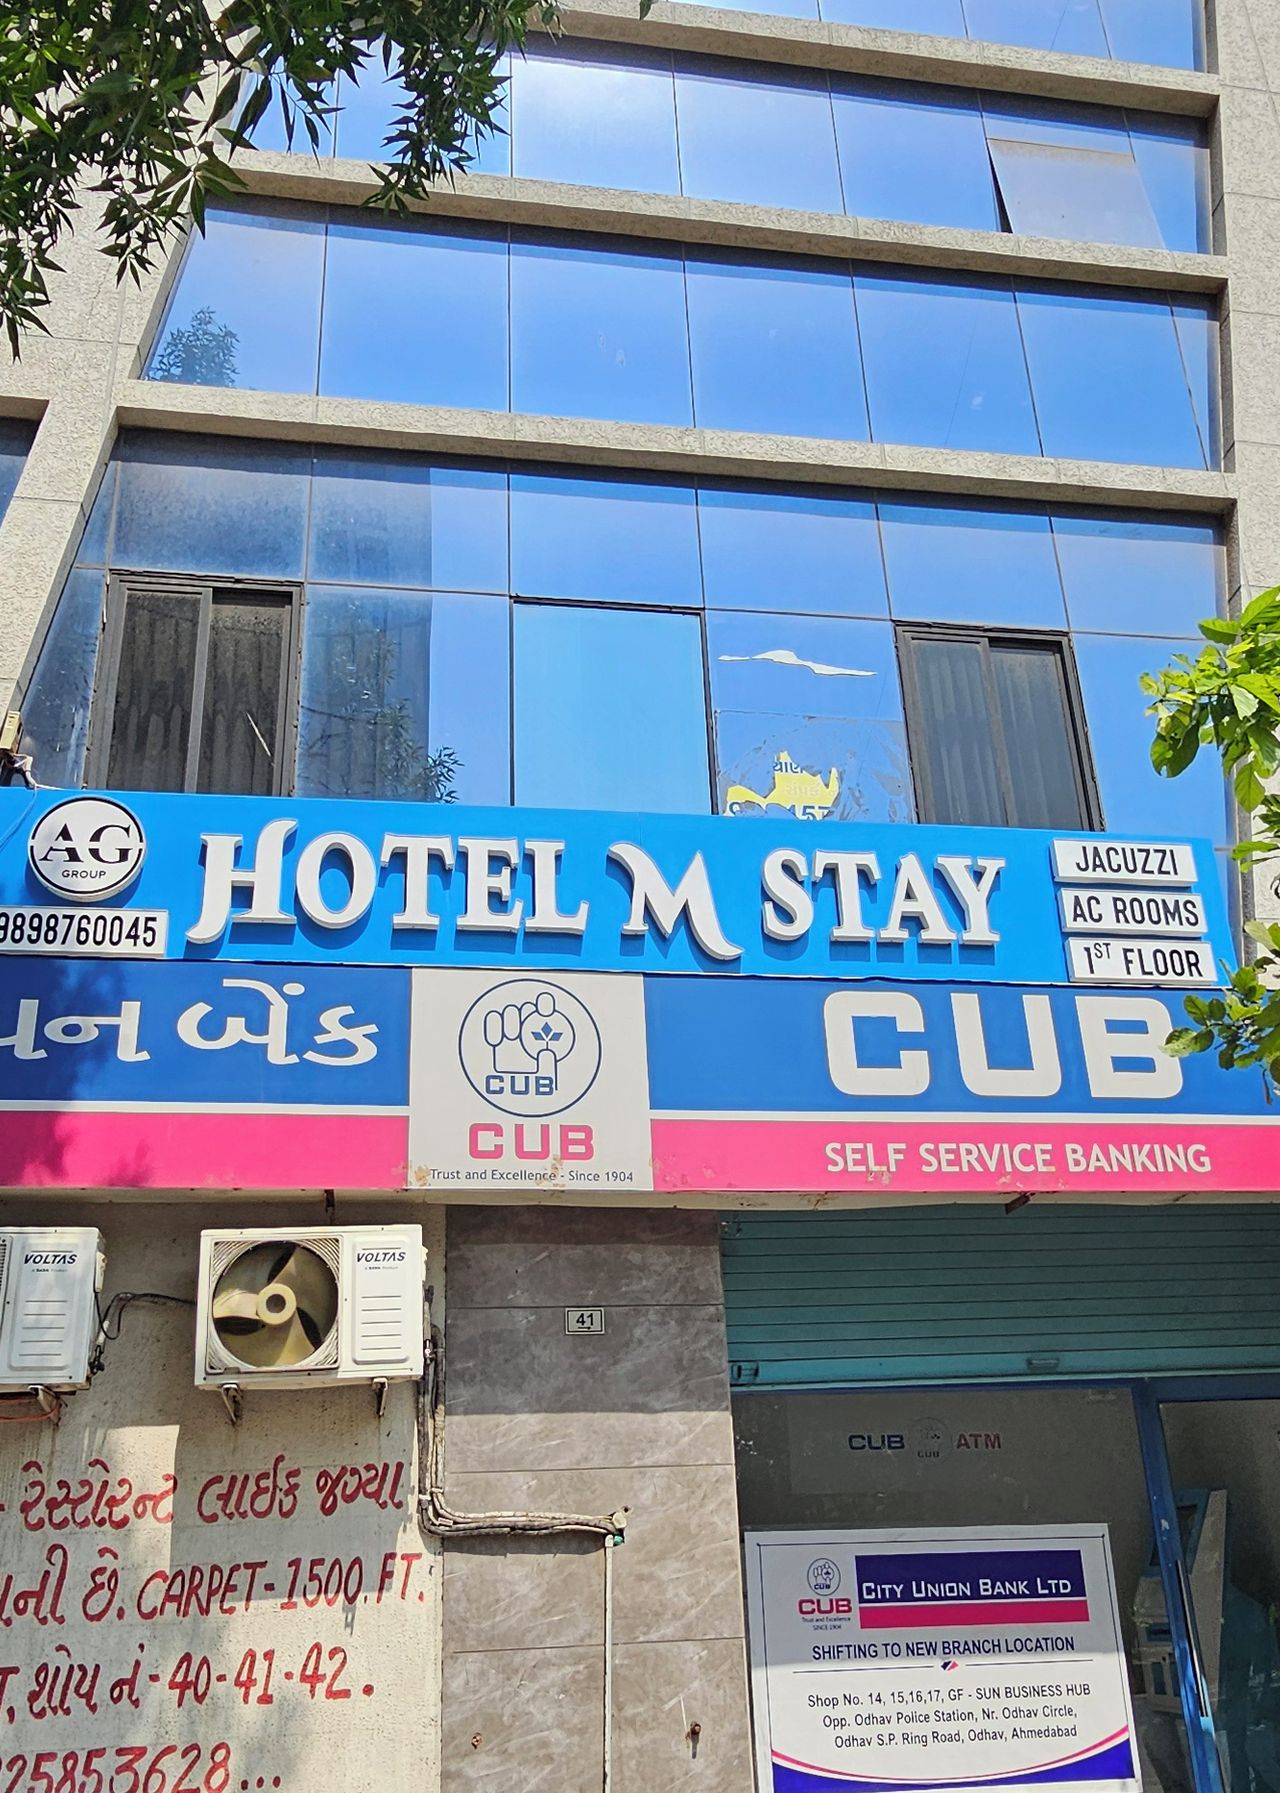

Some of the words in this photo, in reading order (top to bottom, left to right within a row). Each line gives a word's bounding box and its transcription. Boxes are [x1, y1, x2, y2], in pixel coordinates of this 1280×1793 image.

[38, 823, 133, 864] AG
[1075, 846, 1179, 876] JACUZZI
[61, 869, 107, 879] GROUP
[185, 818, 590, 946] HOTEL
[607, 841, 744, 960] M
[760, 848, 1006, 946] STAY
[1072, 895, 1103, 924] AC
[1111, 896, 1199, 927] ROOMS
[1122, 948, 1203, 977] FLOOR
[176, 977, 380, 1068] બેંક
[823, 990, 1185, 1100] CUB
[484, 1074, 558, 1096] CUB
[468, 1122, 595, 1161] CUB
[825, 1142, 906, 1173] SELF
[921, 1142, 1054, 1174] SERVICE
[1065, 1143, 1211, 1175] BANKING
[431, 1169, 461, 1180] Trust
[465, 1169, 488, 1180] and
[491, 1170, 557, 1181] Excellence
[569, 1170, 600, 1182] Since
[605, 1171, 633, 1182] 1904
[24, 1254, 78, 1264] VOLTAS
[357, 1252, 406, 1262] VOLTAS
[576, 1313, 595, 1326] 41
[847, 1434, 905, 1450] CUB
[956, 1433, 1002, 1449] ATM
[862, 1582, 904, 1599] CITY
[912, 1580, 971, 1598] UNION
[979, 1578, 1030, 1595] BANK
[1036, 1577, 1072, 1594] LTD
[798, 1598, 852, 1615] CUB
[812, 1642, 878, 1660] SHIFTING
[882, 1641, 901, 1657] TO
[906, 1640, 938, 1656] NEW
[942, 1638, 1001, 1655] BRANCH
[1005, 1636, 1075, 1653] LOCATION
[808, 1694, 839, 1709] Shop
[843, 1692, 863, 1706] No.
[868, 1692, 886, 1706] 14,
[891, 1689, 944, 1704] 15,16,17,
[948, 1688, 964, 1701] GF
[975, 1687, 1001, 1700] SUN
[1004, 1684, 1063, 1699] BUSINESS
[1066, 1683, 1091, 1697] HUB
[823, 1714, 851, 1731] Opp.
[854, 1712, 892, 1726] Odhav
[896, 1710, 930, 1724] Police
[933, 1708, 978, 1723] Station,
[982, 1707, 998, 1720] Nr.
[1002, 1706, 1038, 1719] Odhav
[1042, 1704, 1078, 1719] Circle,
[834, 1735, 873, 1748] Odhav
[877, 1733, 898, 1746] S.P.
[902, 1732, 928, 1748] Ring
[931, 1730, 964, 1744] Road,
[967, 1728, 1008, 1742] Odhav,
[1011, 1724, 1078, 1740] Ahmedabad
